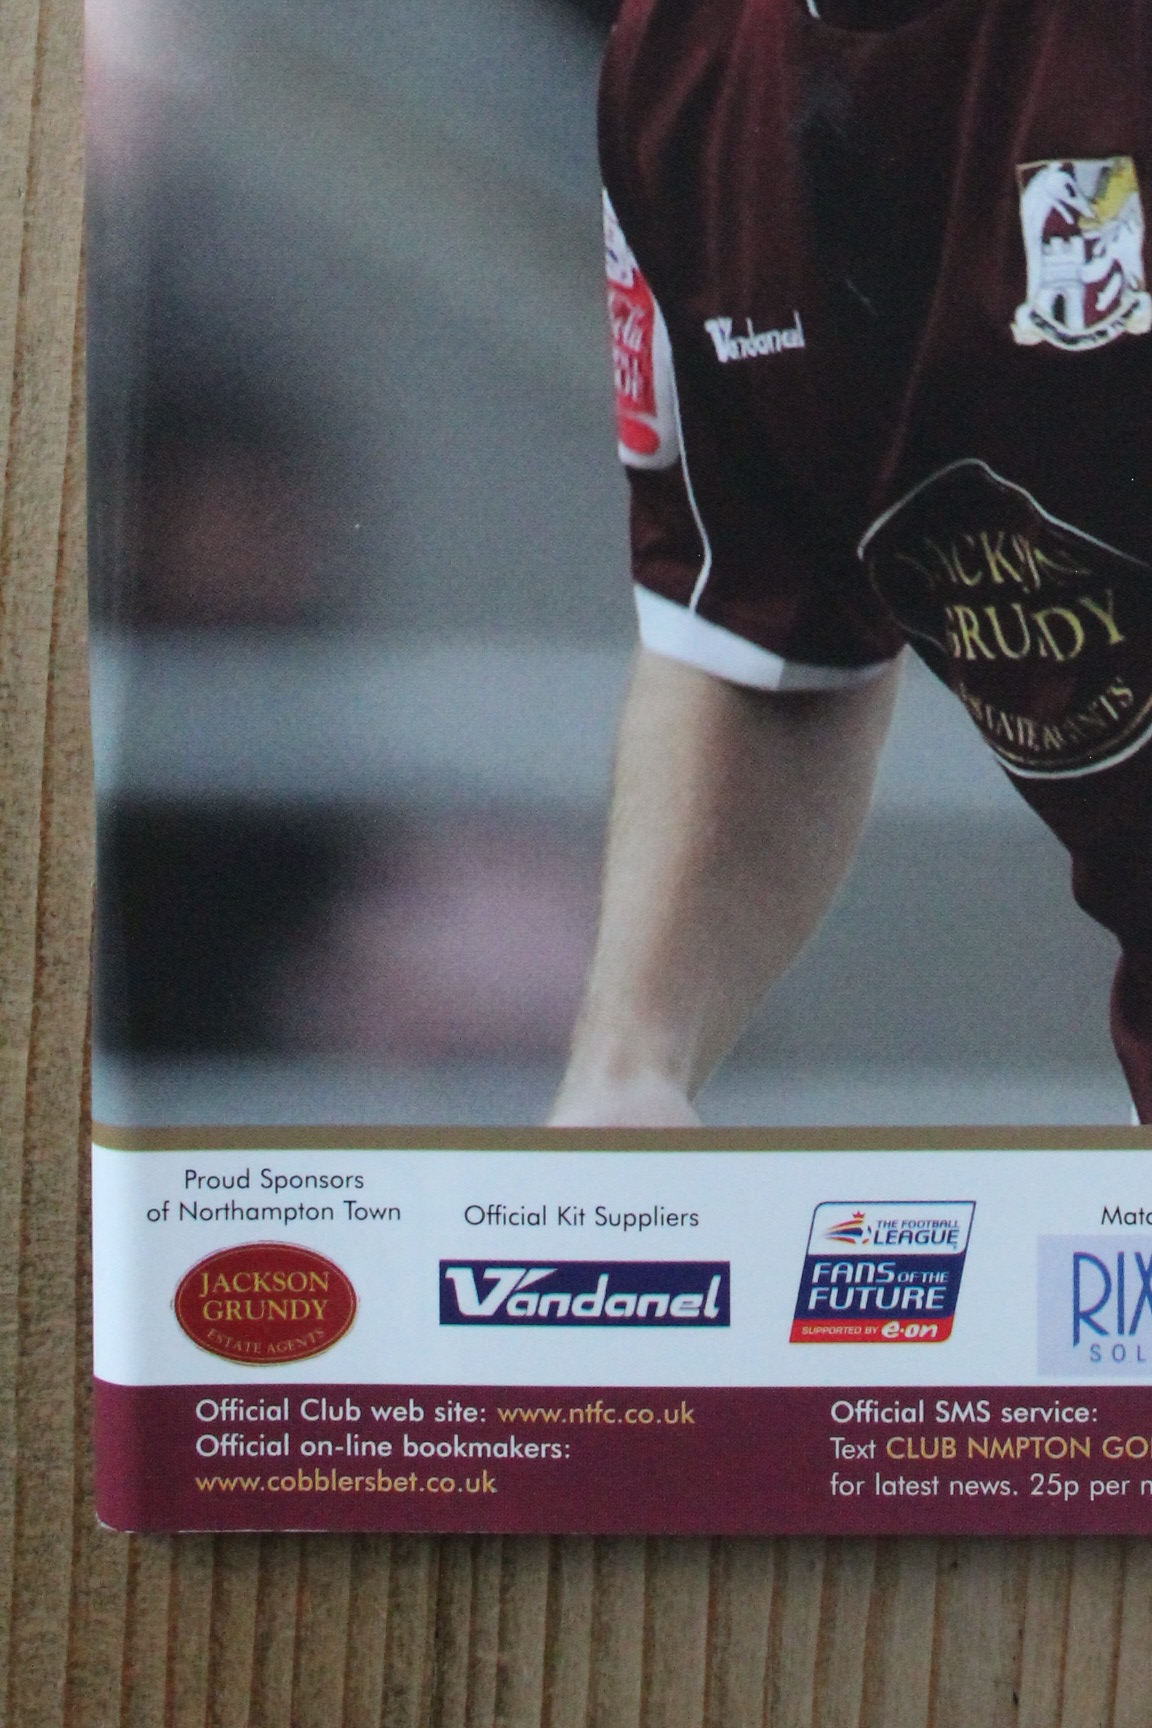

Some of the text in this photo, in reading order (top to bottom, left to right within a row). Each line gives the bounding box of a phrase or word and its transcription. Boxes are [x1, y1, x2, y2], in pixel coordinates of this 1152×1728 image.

[185, 1168, 364, 1194] Proud Sponsors
[147, 1200, 400, 1225] of Northampton Town
[464, 1204, 699, 1231] Official Kit Suppliers
[876, 1219, 959, 1229] THE FOOTBALL
[873, 1230, 959, 1246] LEAGUE
[200, 1271, 329, 1298] JACKSON
[444, 1268, 720, 1320] Vandanel
[202, 1299, 328, 1321] GRUNDY
[808, 1286, 947, 1311] FUTURE
[801, 1326, 862, 1335] SUPPORTED
[196, 1398, 695, 1424] Official Club web site: www.ntfc.co.uk
[831, 1400, 1097, 1423] Official SMS service:
[196, 1433, 569, 1458] Official on-line bookmakers:
[830, 1437, 876, 1459] Text
[886, 1437, 956, 1459] CLUB
[968, 1436, 1090, 1459] NMPTON
[196, 1468, 497, 1493] www.cobblersbet.co.uk
[830, 1472, 864, 1496] for
[876, 1473, 939, 1496] latest
[950, 1481, 1017, 1496] news.
[1030, 1473, 1079, 1501] 25p
[1090, 1480, 1130, 1501] per
